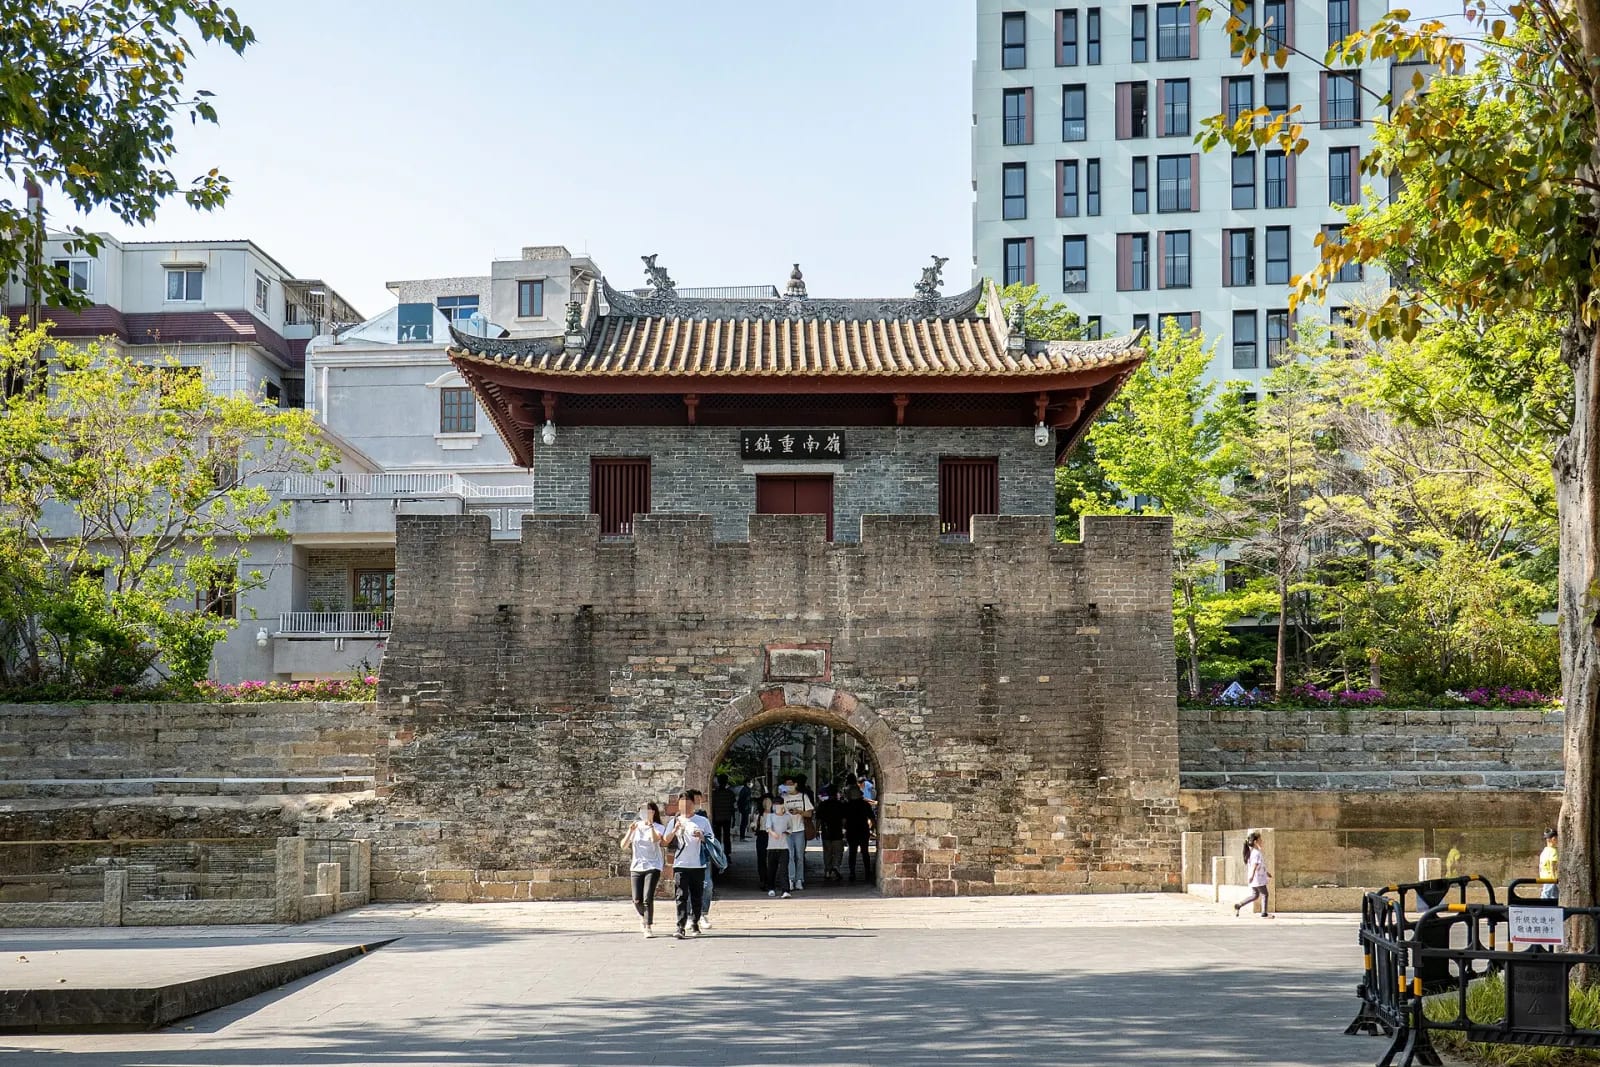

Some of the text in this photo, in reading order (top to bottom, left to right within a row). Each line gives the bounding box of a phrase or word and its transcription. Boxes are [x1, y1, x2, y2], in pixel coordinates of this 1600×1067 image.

[754, 432, 841, 455] 嶺南重鎮
[1515, 915, 1556, 925] 升级改造中
